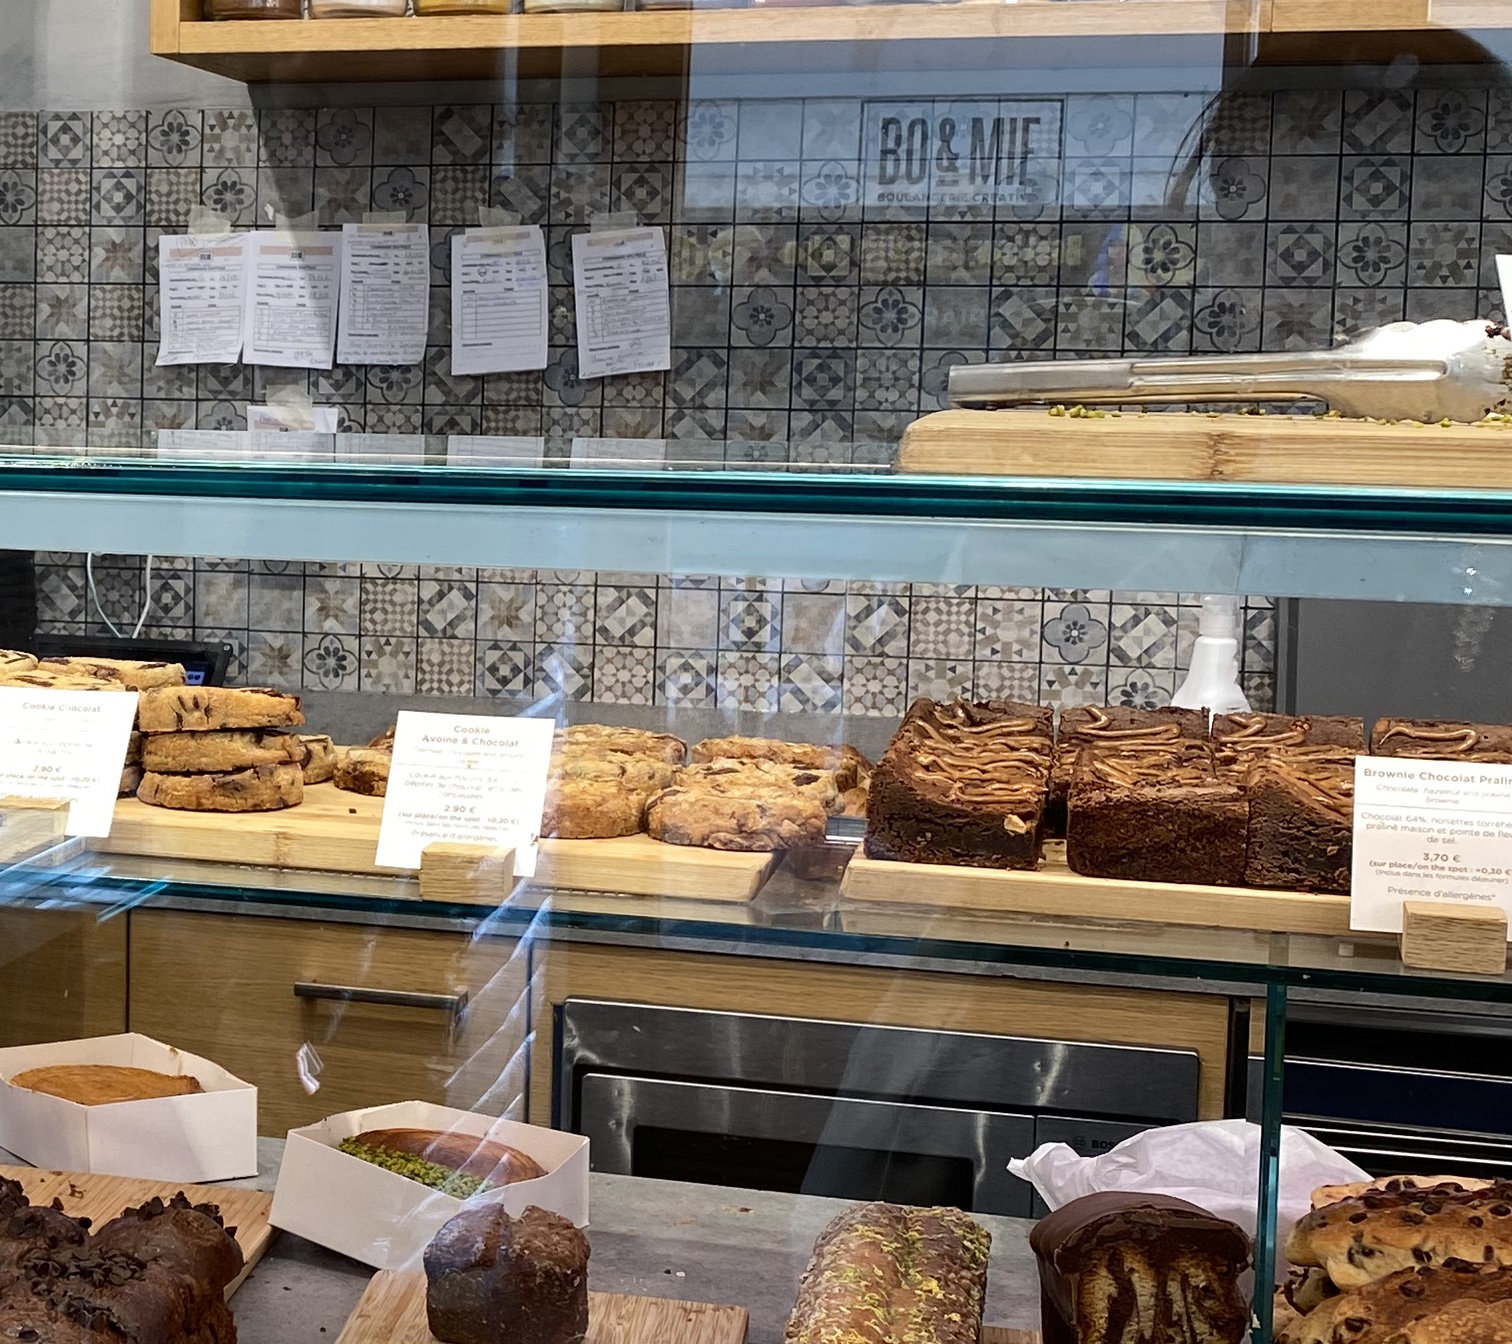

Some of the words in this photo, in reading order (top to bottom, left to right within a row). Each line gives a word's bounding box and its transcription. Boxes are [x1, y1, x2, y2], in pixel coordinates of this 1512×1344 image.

[454, 726, 490, 734] Cookie
[422, 735, 458, 744] Avoine
[472, 738, 519, 747] Chocolat
[1364, 768, 1414, 779] Brownie
[1419, 772, 1475, 783] Chocolat
[1401, 826, 1434, 834] maison
[1423, 852, 1448, 862] 3,70
[1453, 855, 1461, 863] €
[1092, 1140, 1114, 1149] BOS
